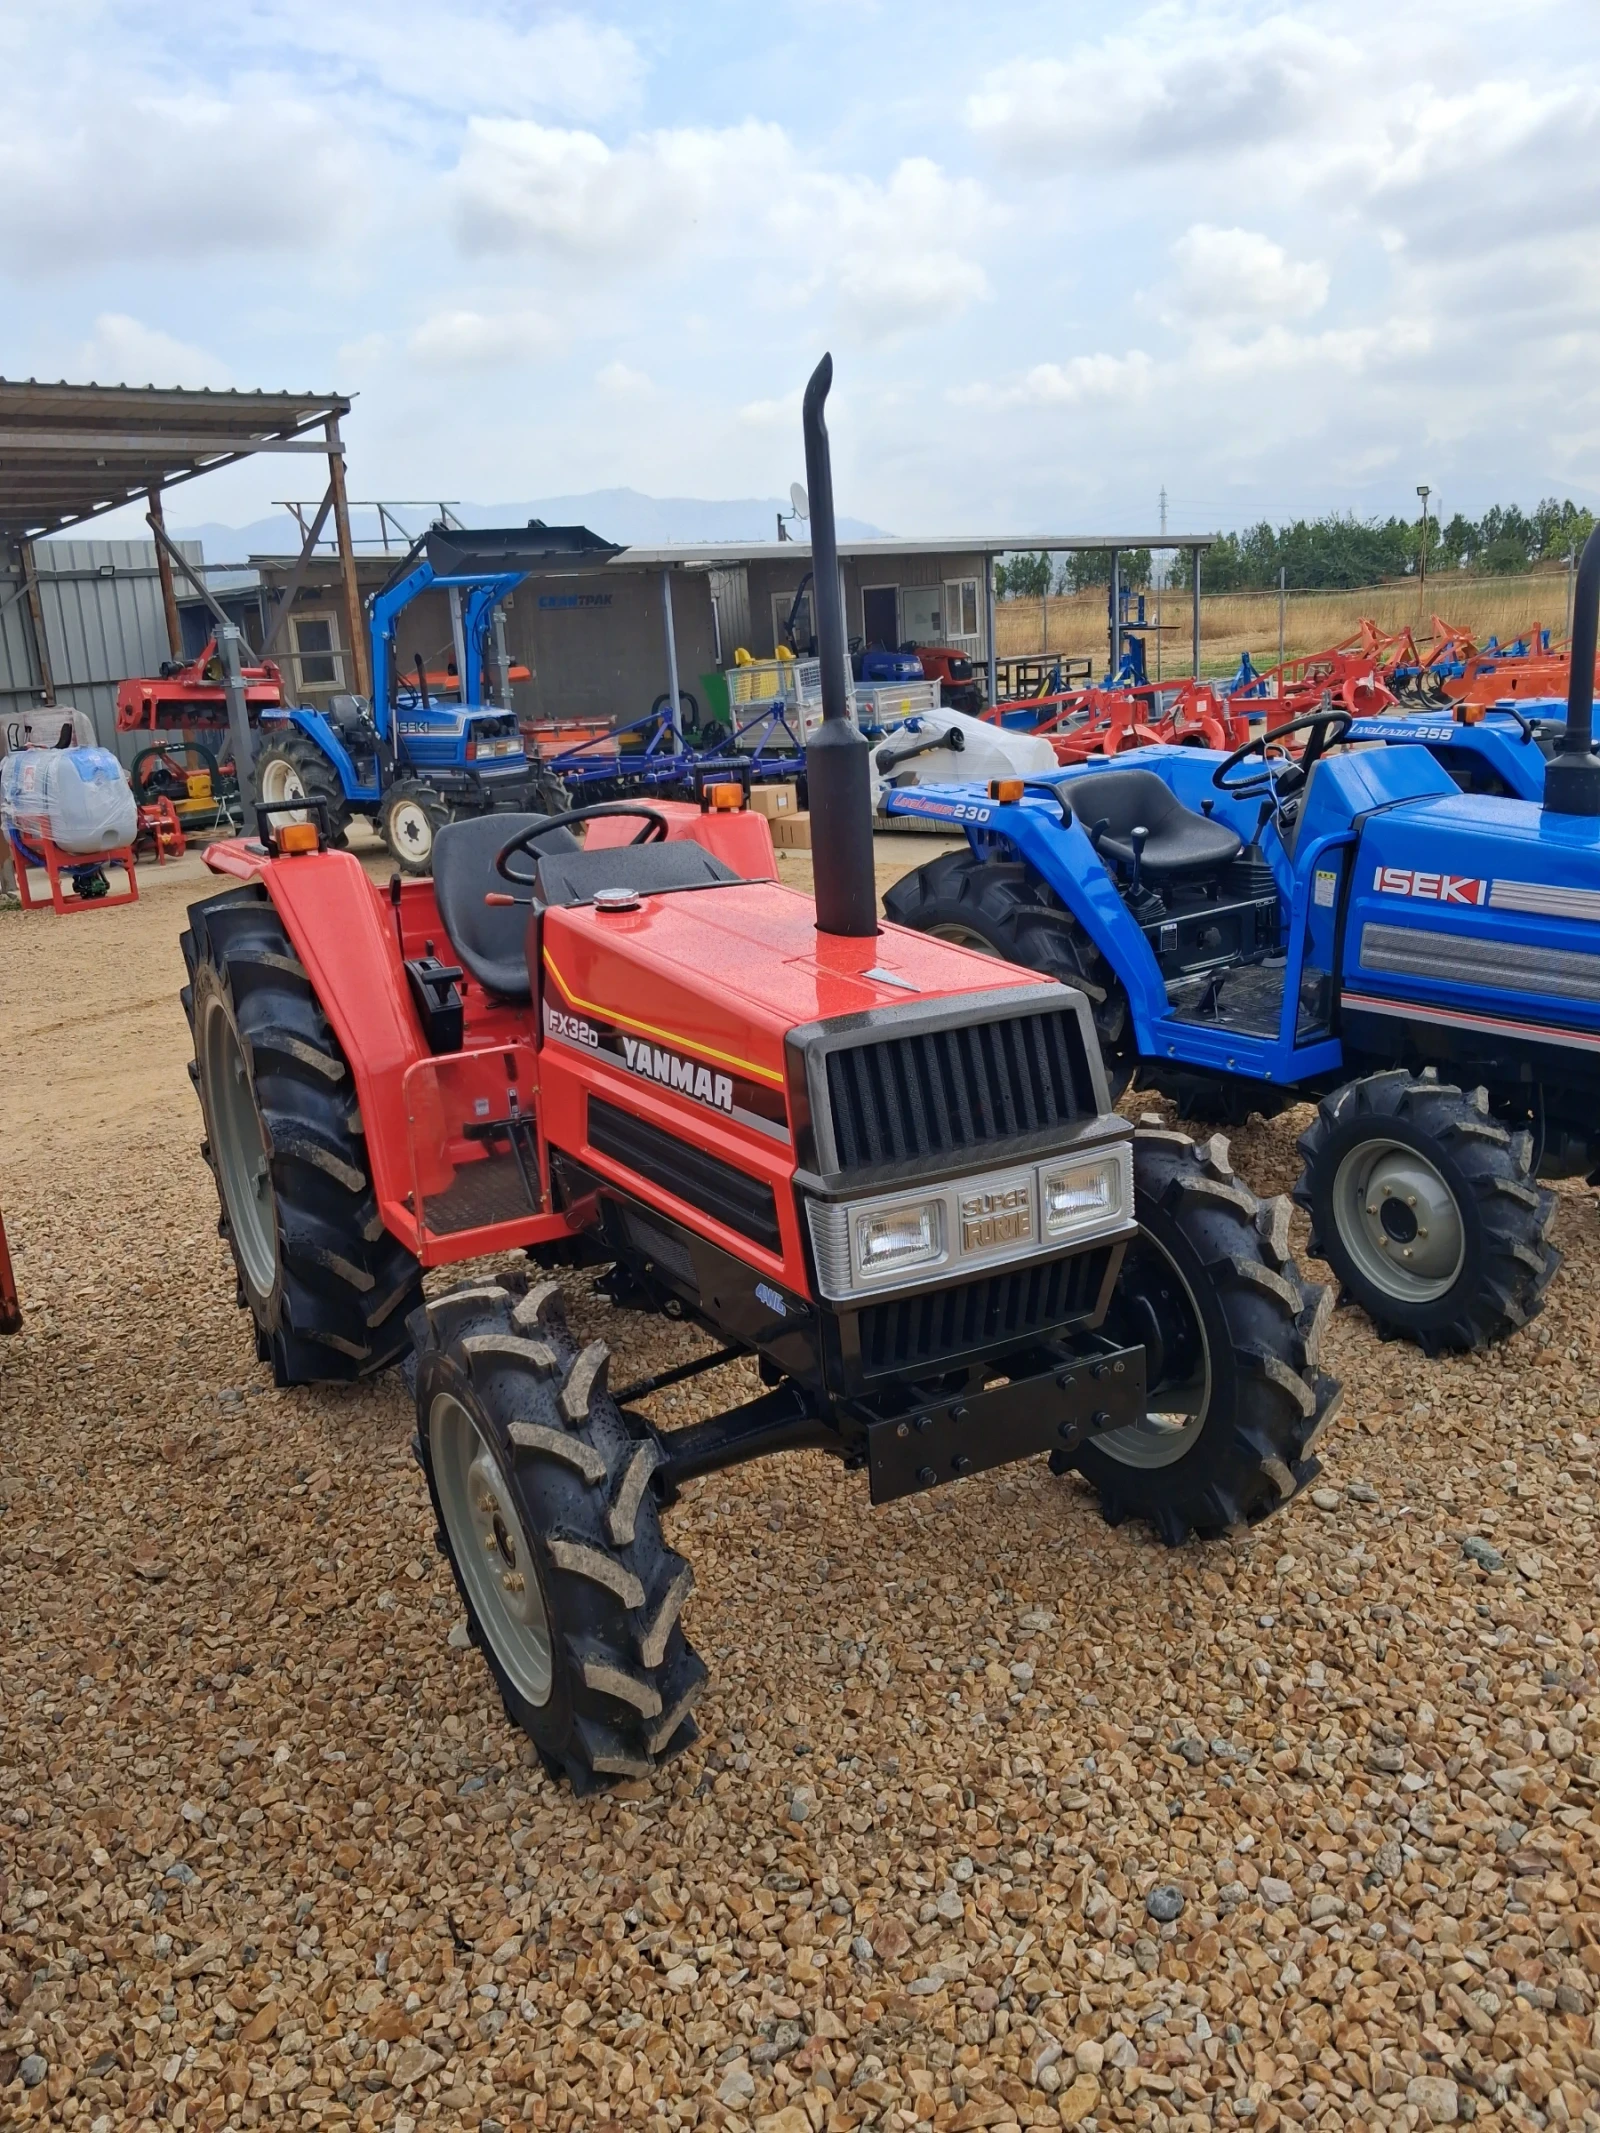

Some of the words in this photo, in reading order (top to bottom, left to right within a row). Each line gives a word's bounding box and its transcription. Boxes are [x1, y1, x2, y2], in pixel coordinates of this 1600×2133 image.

[396, 722, 428, 733] ISEKI
[1415, 726, 1454, 741] 255
[953, 804, 991, 822] 230
[1372, 866, 1488, 906] ISEKI
[549, 1009, 599, 1049] FX32D
[622, 1036, 733, 1113] YANMAR
[963, 1187, 1029, 1218] SUPER
[963, 1209, 1031, 1250] FORTE
[755, 1282, 787, 1317] 4WD
